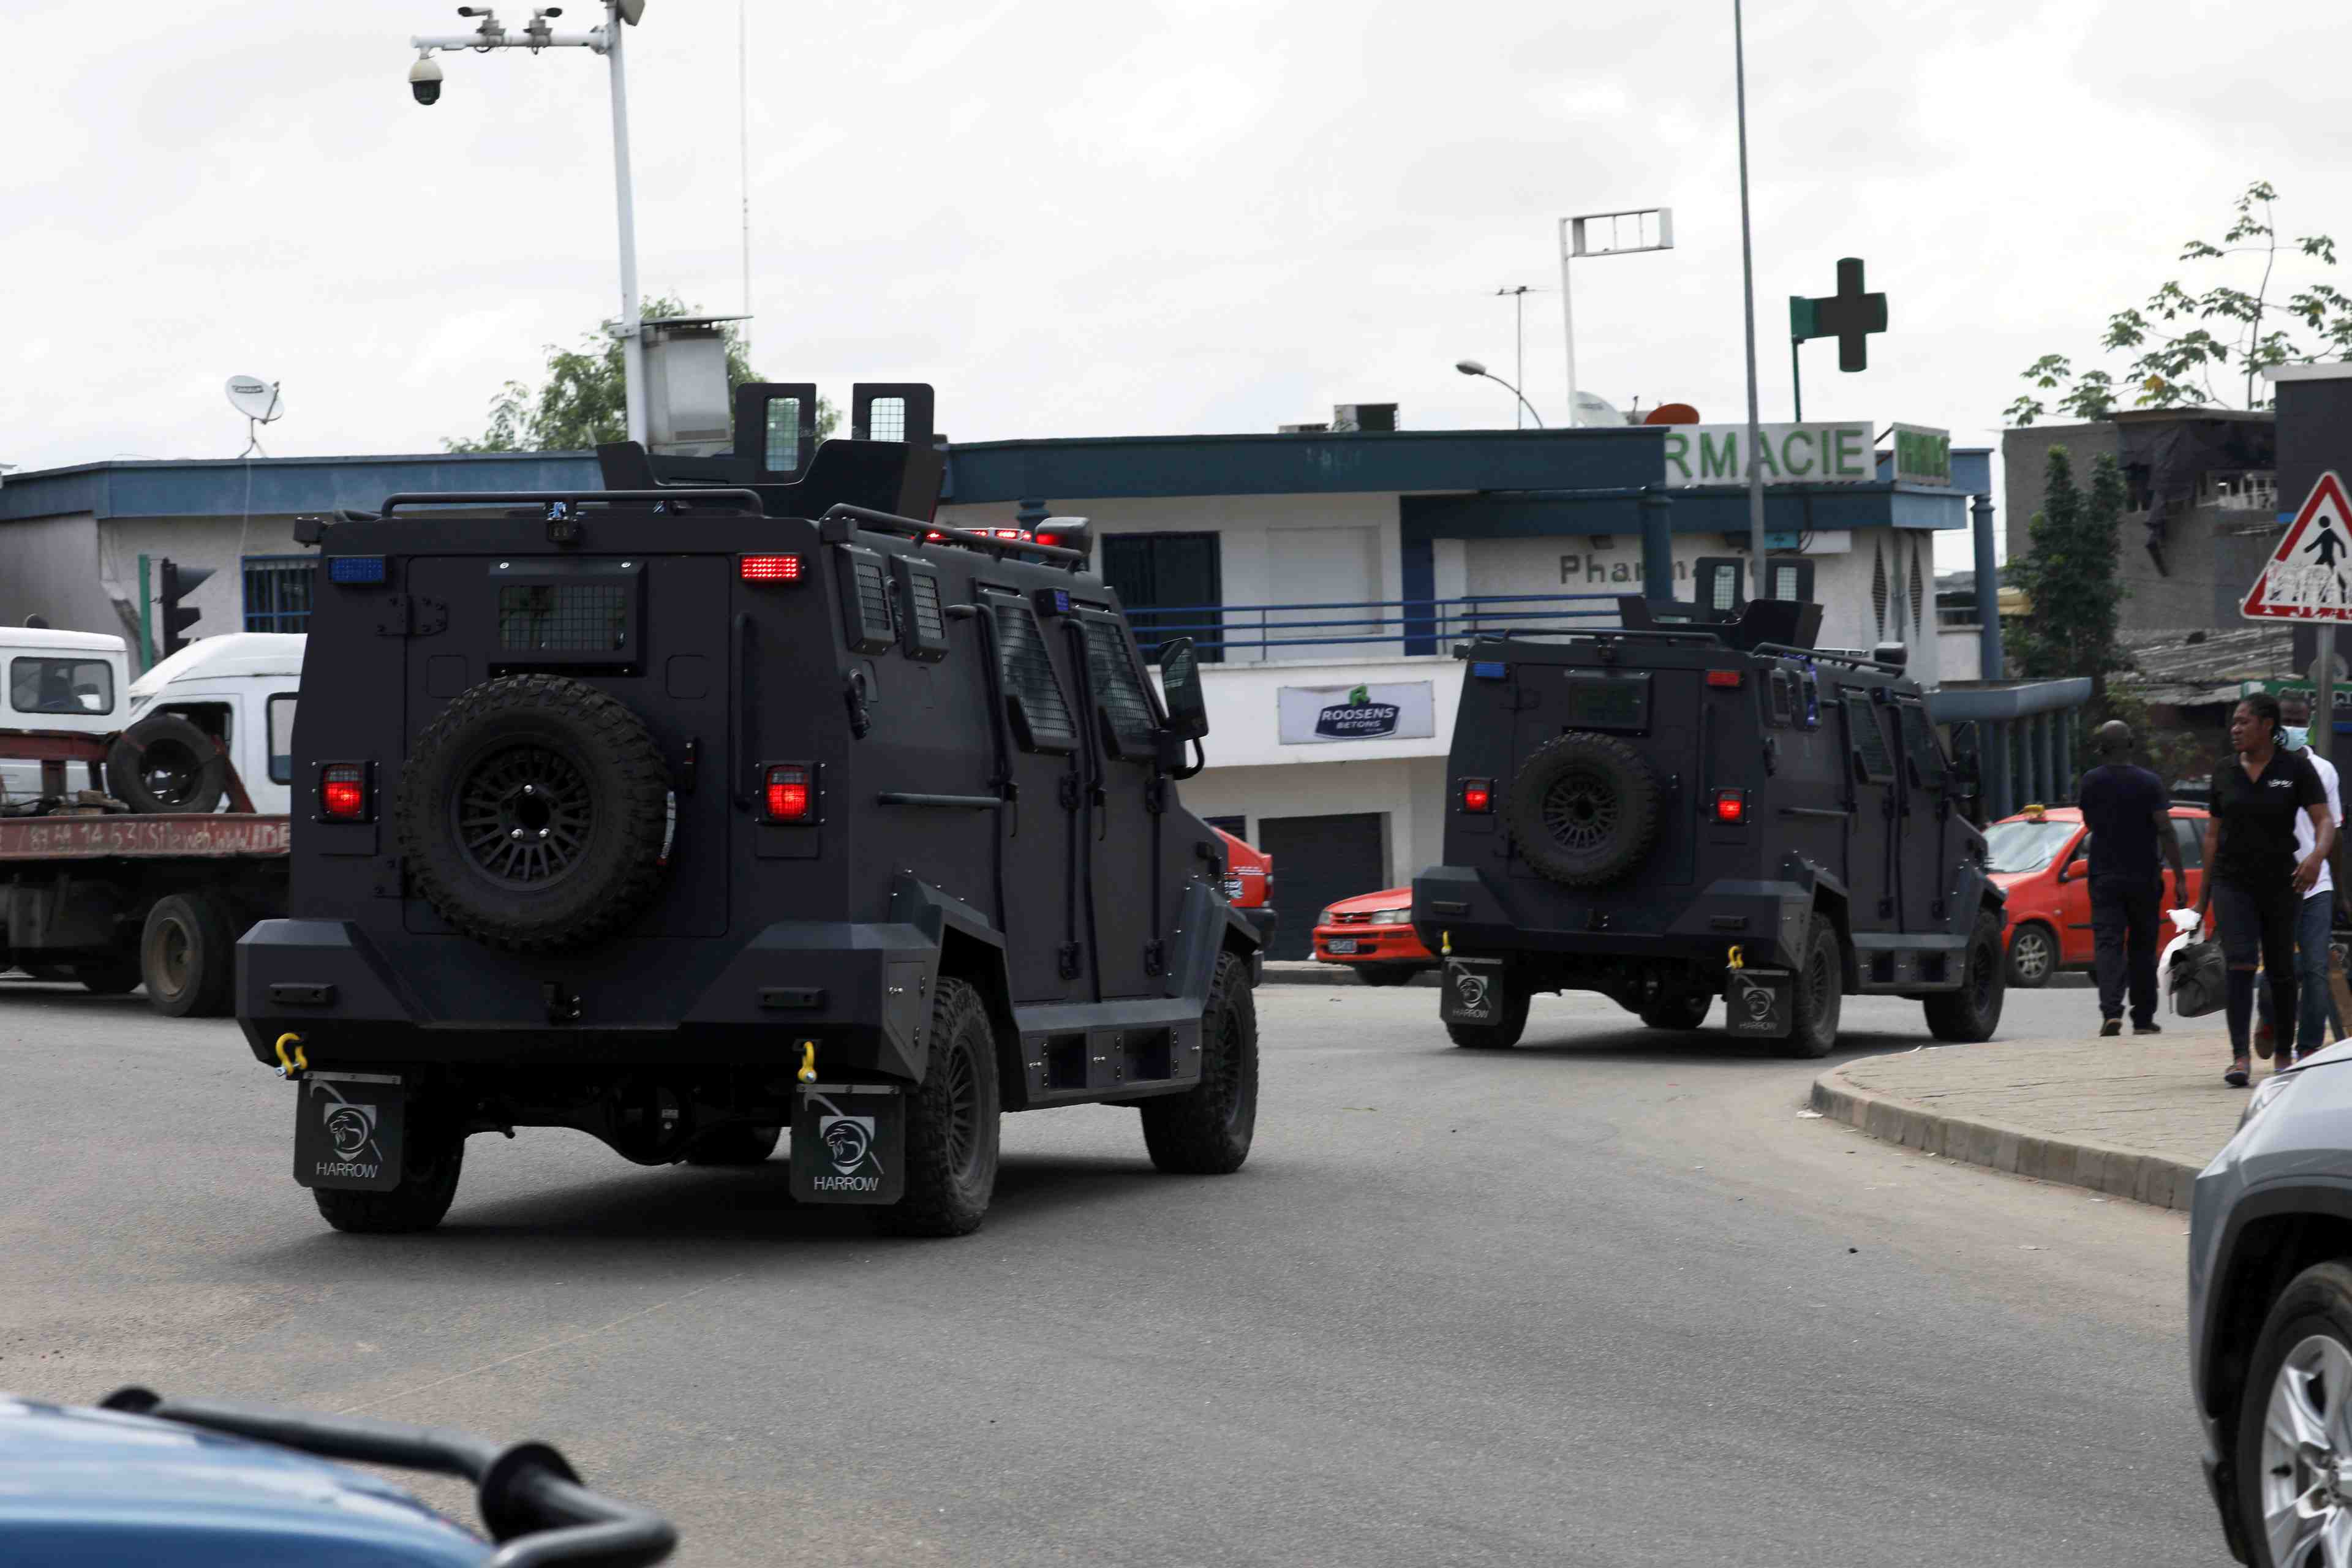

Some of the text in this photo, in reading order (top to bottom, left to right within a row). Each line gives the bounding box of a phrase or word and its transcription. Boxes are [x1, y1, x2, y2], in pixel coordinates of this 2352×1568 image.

[1321, 707, 1395, 721] ROOSENS
[315, 1162, 378, 1178] HARROW
[814, 1176, 879, 1191] HARROW
